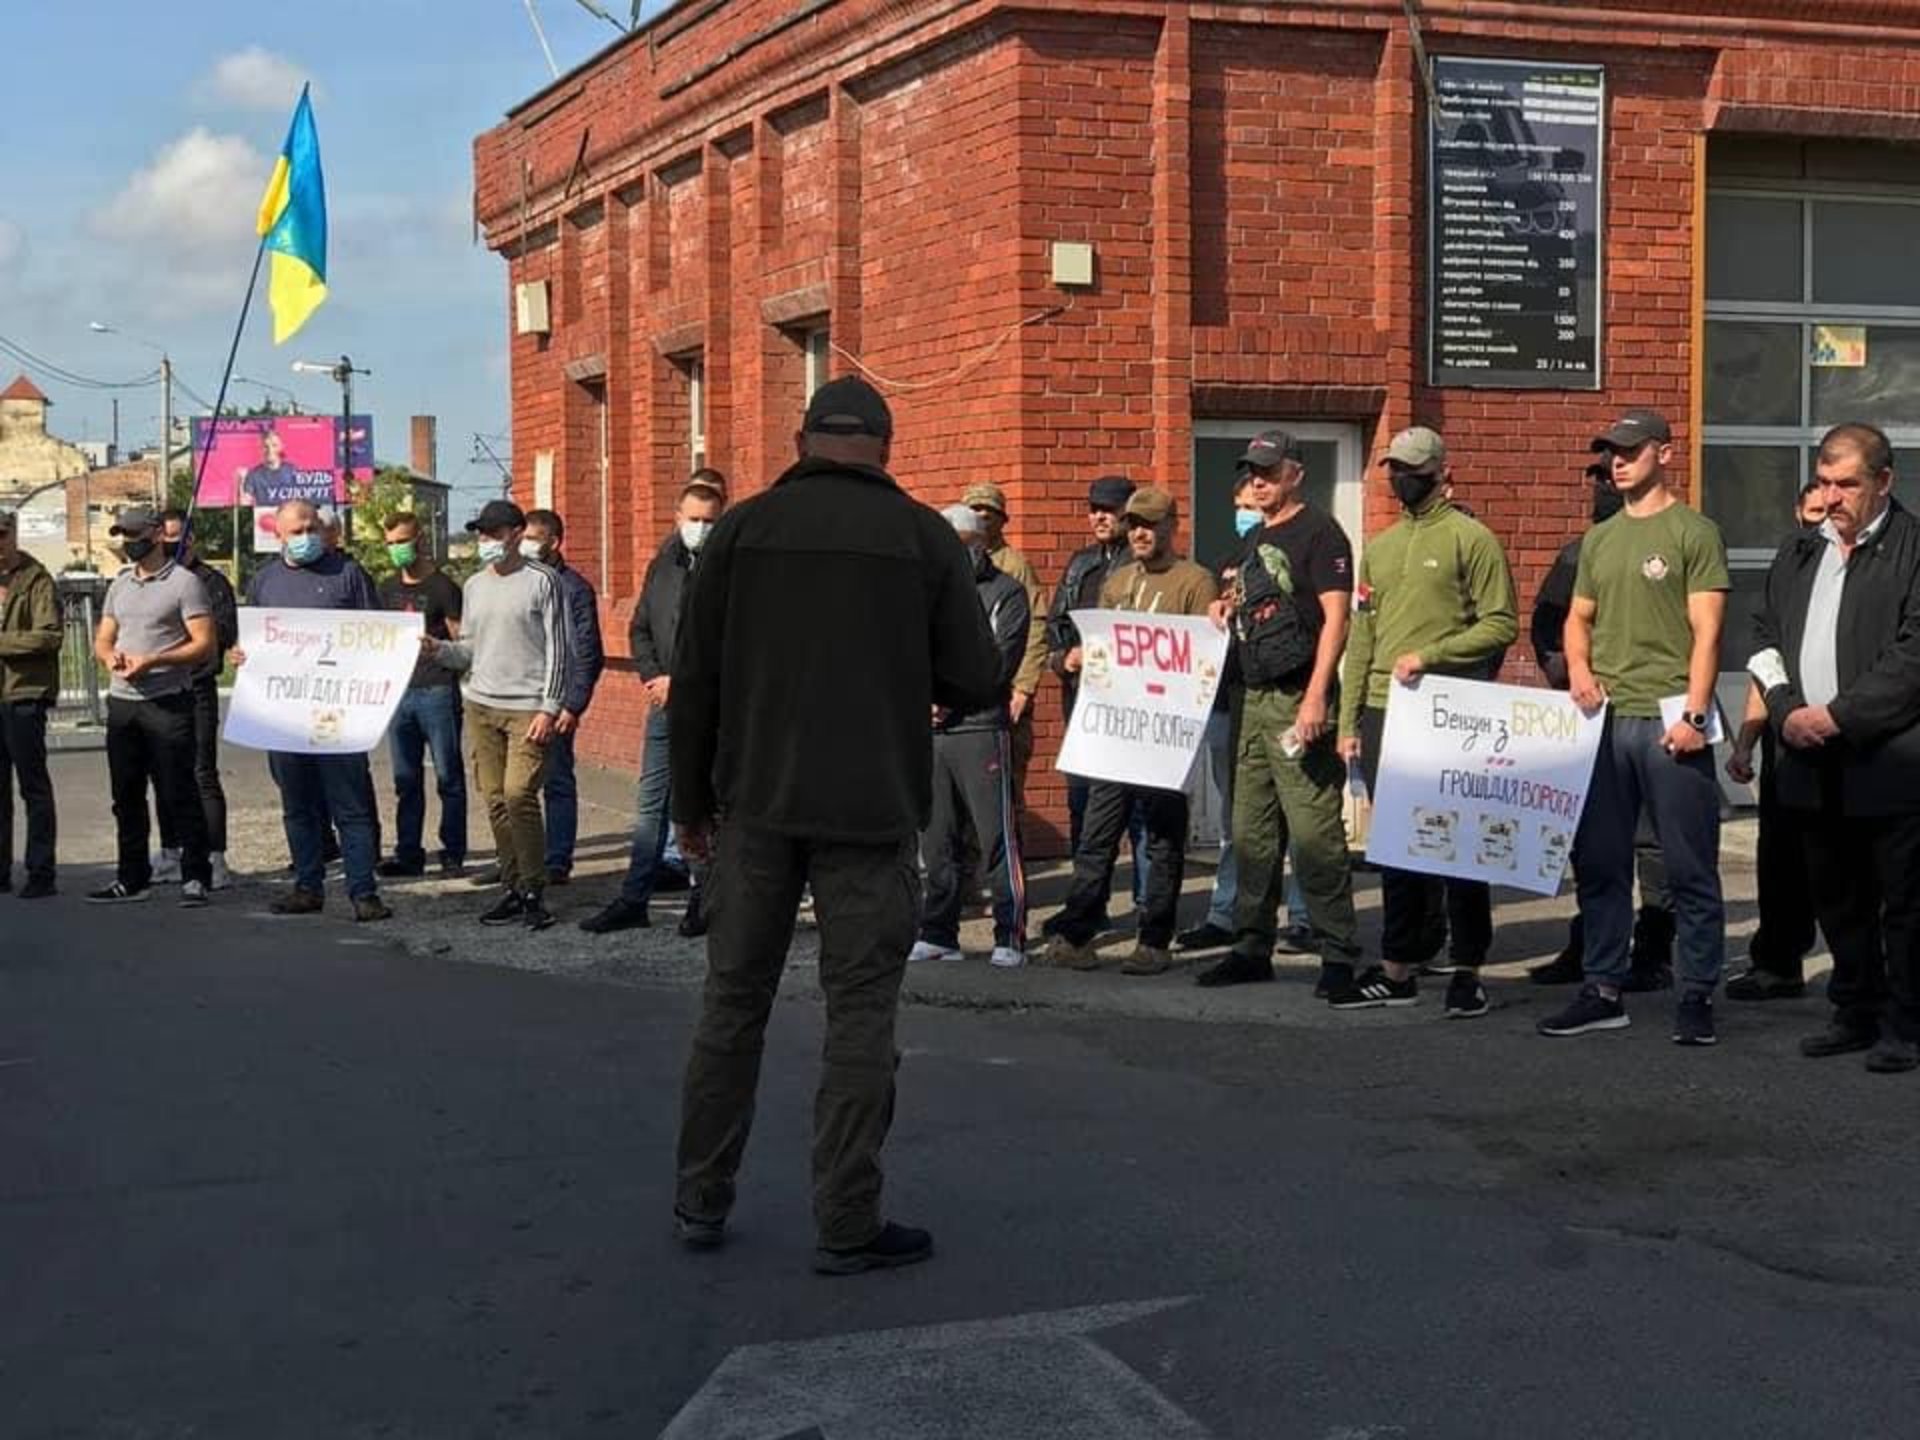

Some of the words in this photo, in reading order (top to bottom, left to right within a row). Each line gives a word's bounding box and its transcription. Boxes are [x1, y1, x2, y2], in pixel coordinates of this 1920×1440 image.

[295, 471, 333, 485] БУДЬ
[1113, 623, 1192, 674] БРСМ
[1511, 699, 1579, 743] БРСМ
